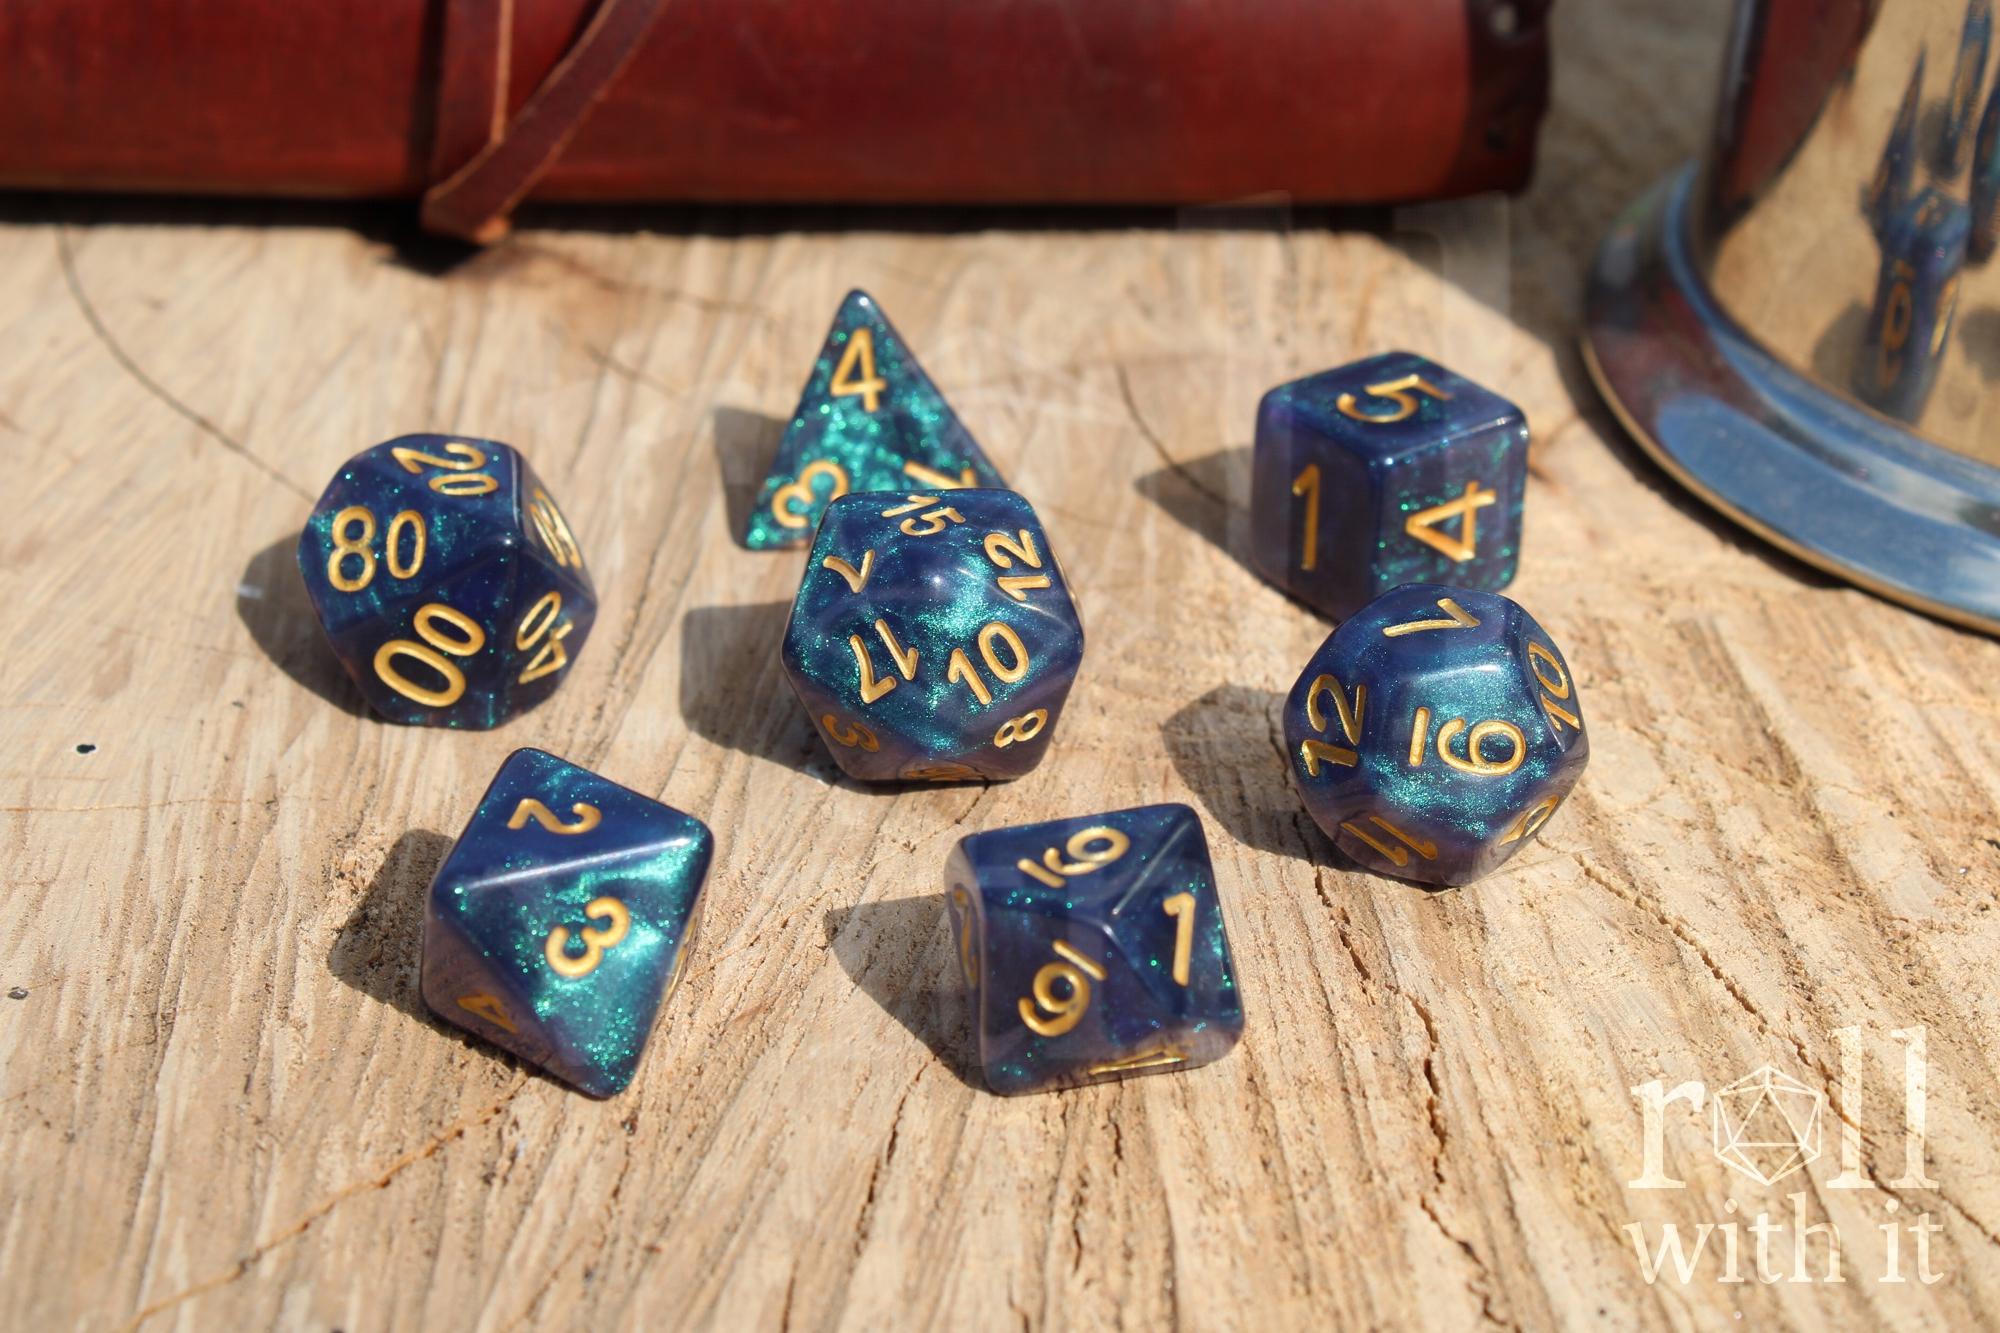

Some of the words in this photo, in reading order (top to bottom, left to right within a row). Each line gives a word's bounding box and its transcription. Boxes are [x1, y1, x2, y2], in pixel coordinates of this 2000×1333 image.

[830, 327, 887, 413] 4
[1336, 373, 1455, 423] 5
[391, 443, 499, 496] 20
[771, 459, 848, 529] 3
[327, 505, 427, 592] 80
[881, 495, 966, 536] 15
[1292, 463, 1320, 571] 1
[1405, 481, 1496, 563] 4
[983, 529, 1051, 601] 12
[373, 602, 486, 707] 00
[516, 591, 574, 685] 40
[849, 619, 919, 704] 17
[948, 621, 1029, 705] 10
[994, 708, 1048, 748] 8
[1301, 674, 1367, 777] 12
[1529, 641, 1580, 732] 10
[507, 798, 602, 835] 2
[1340, 815, 1438, 868] 11
[545, 896, 631, 977] 3
[1163, 892, 1196, 986] 1
